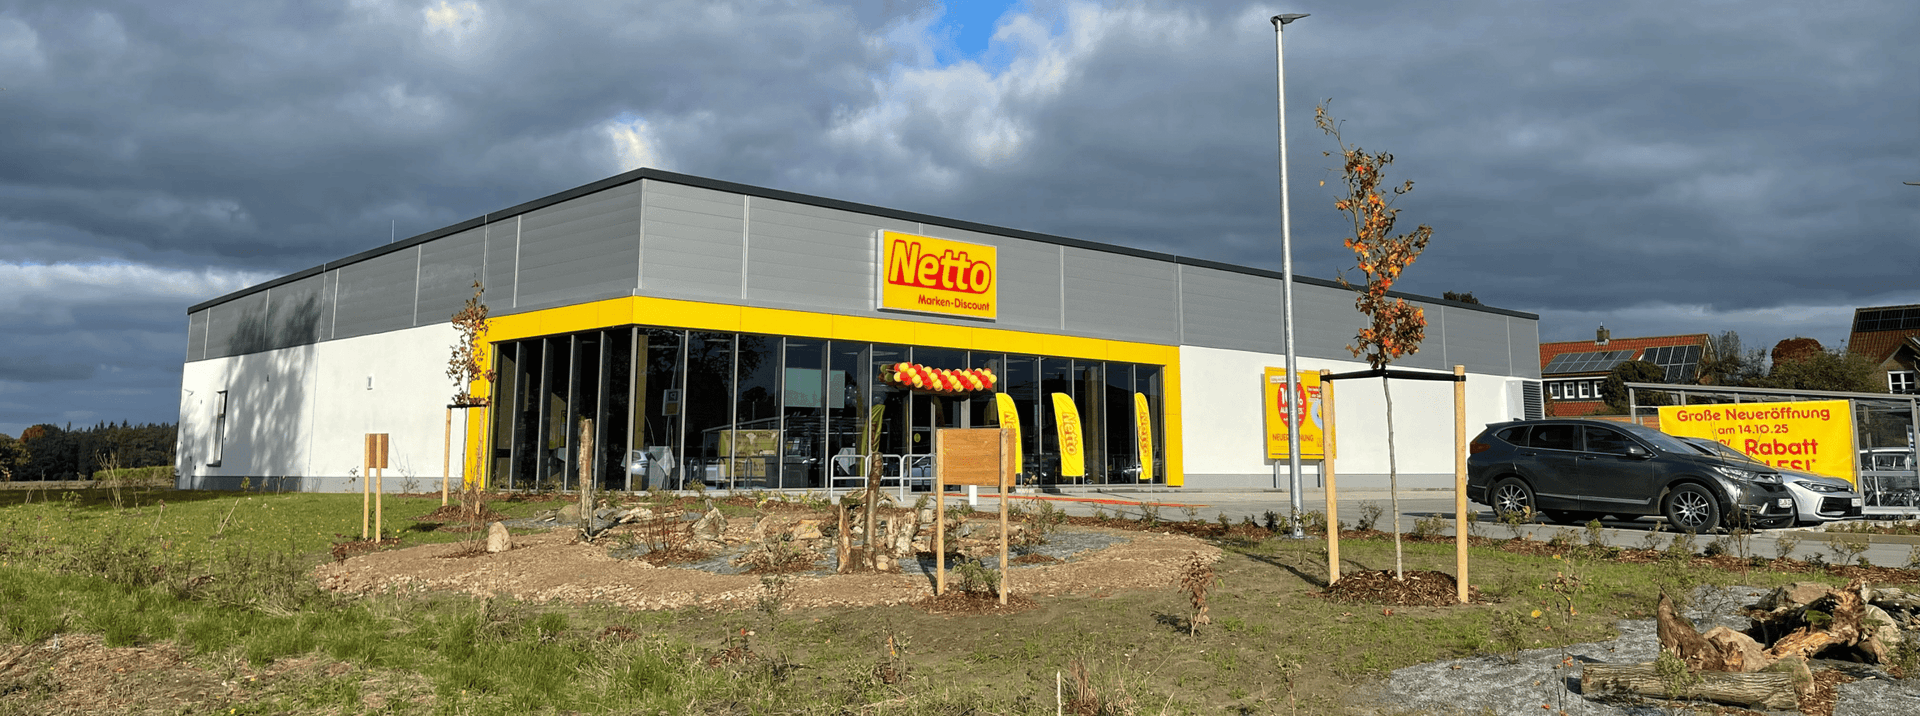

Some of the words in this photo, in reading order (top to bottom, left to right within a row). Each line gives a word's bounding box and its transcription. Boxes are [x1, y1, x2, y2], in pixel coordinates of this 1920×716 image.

[888, 239, 992, 294] Netto
[918, 294, 990, 311] Marken-Discount
[1676, 409, 1721, 422] Große
[1725, 407, 1830, 421] Neueröffnung
[1062, 411, 1079, 456] Netto
[1717, 427, 1736, 435] am
[1738, 424, 1789, 434] 14.10.25
[1744, 438, 1818, 456] Rabatt
